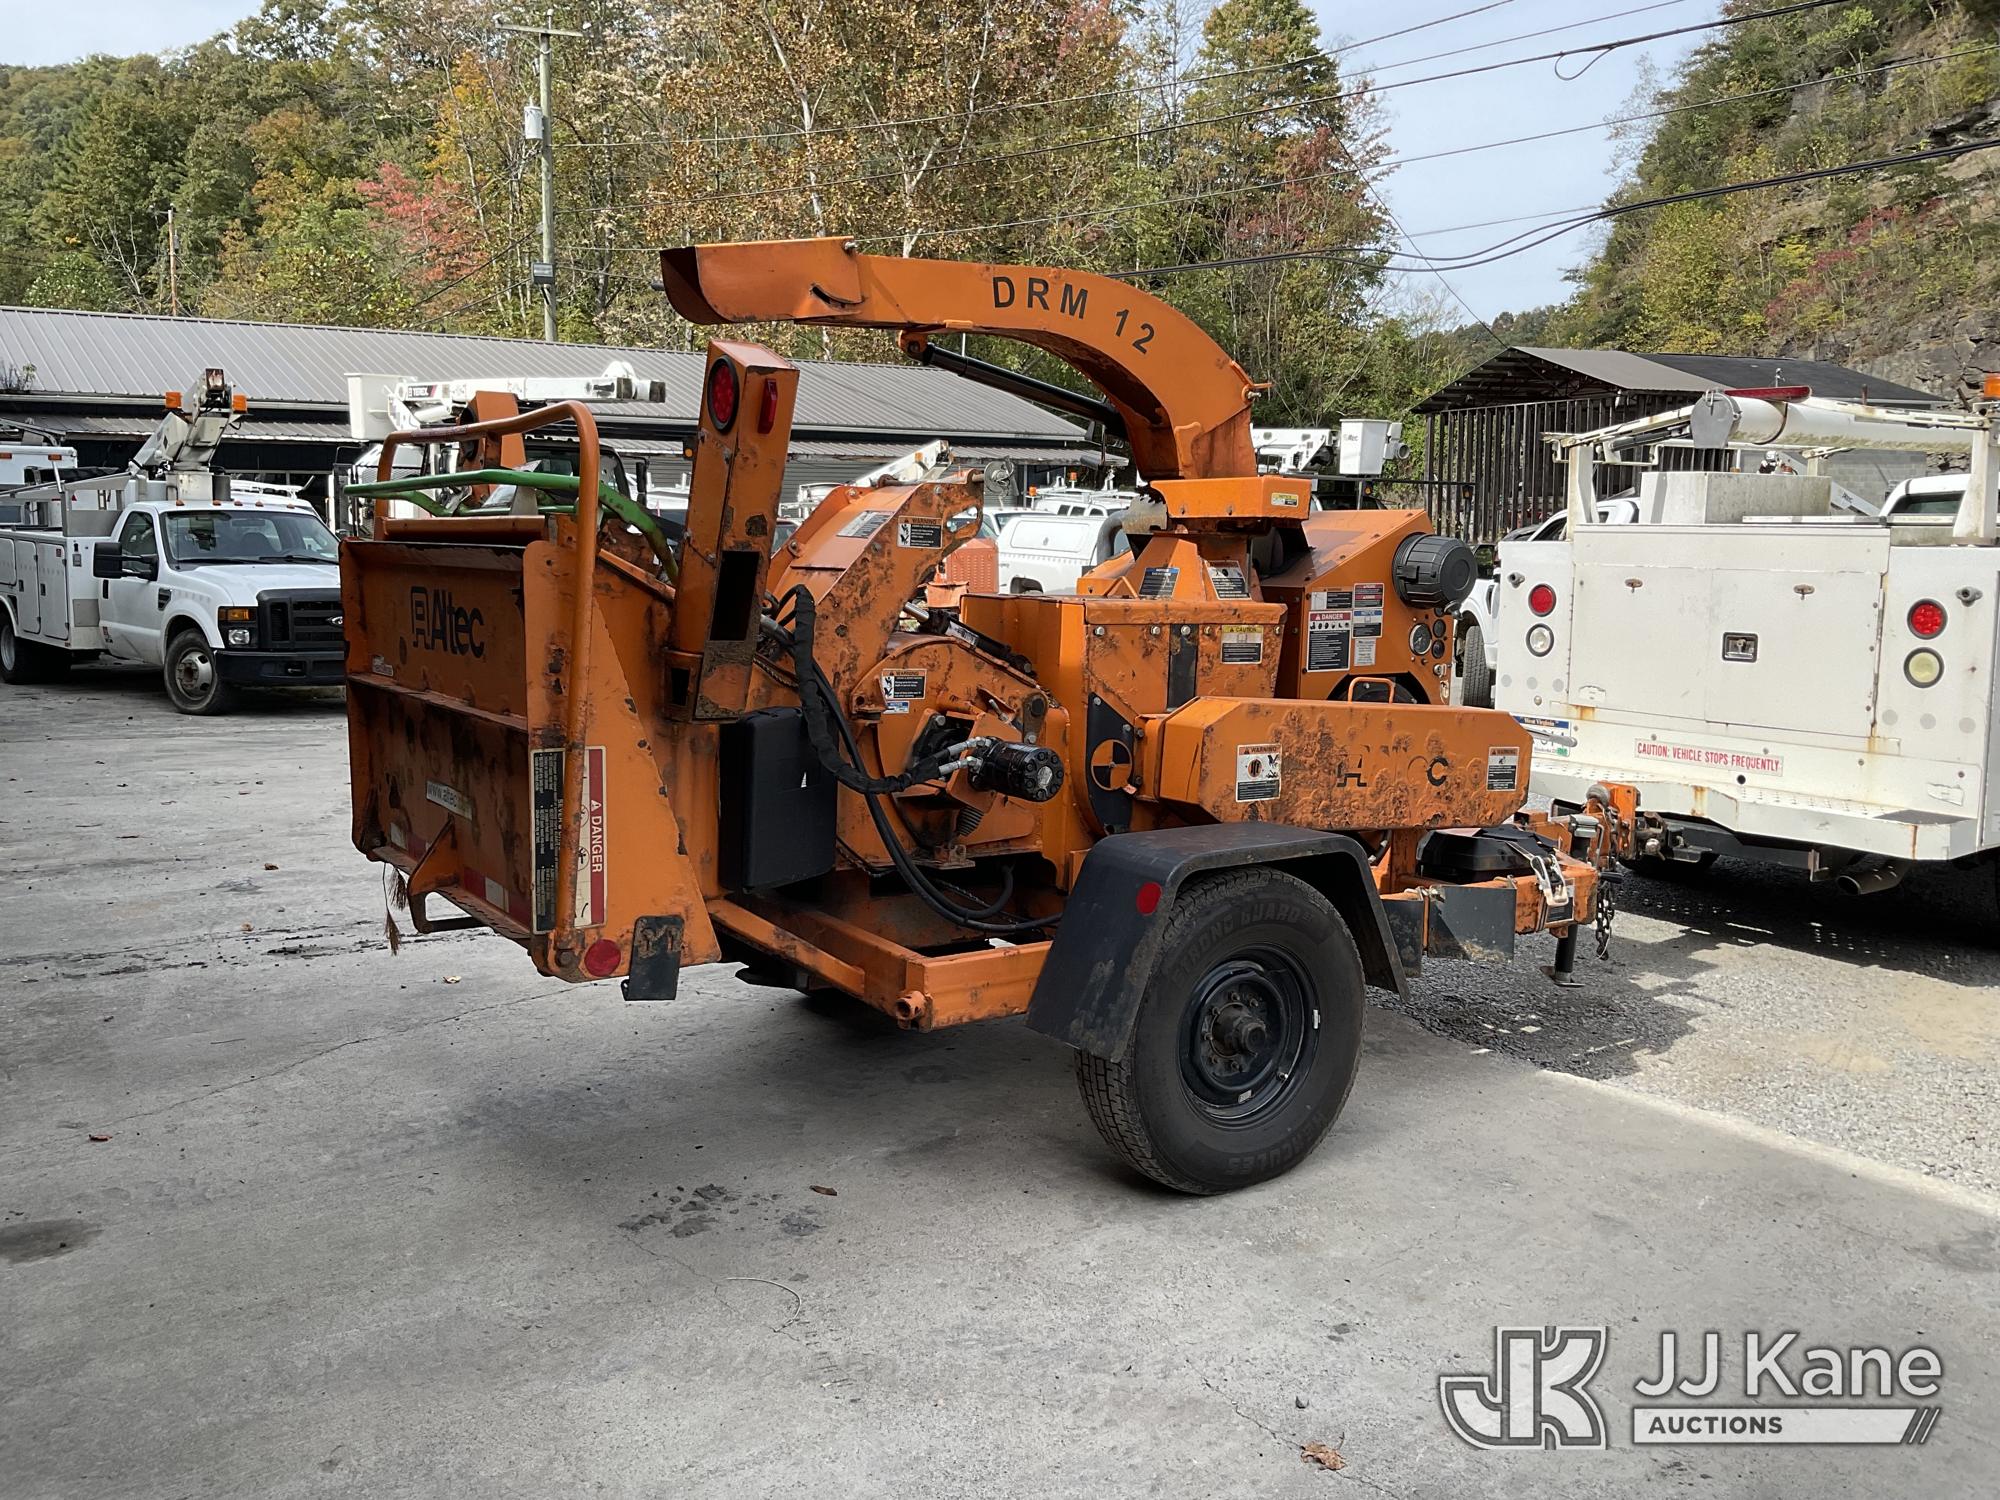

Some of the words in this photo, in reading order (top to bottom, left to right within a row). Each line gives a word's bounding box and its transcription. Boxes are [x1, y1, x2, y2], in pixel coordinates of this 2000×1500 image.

[992, 275, 1089, 320] DRM
[1114, 308, 1156, 355] 12
[431, 589, 486, 659] Altec
[1637, 742, 1670, 758] CAUTION:
[1672, 747, 1702, 762] VEHICLE
[1704, 751, 1729, 766] STOPS
[1731, 754, 1780, 772] FREQUENTLY
[591, 815, 603, 873] DANGER
[1240, 901, 1300, 926] GUARD
